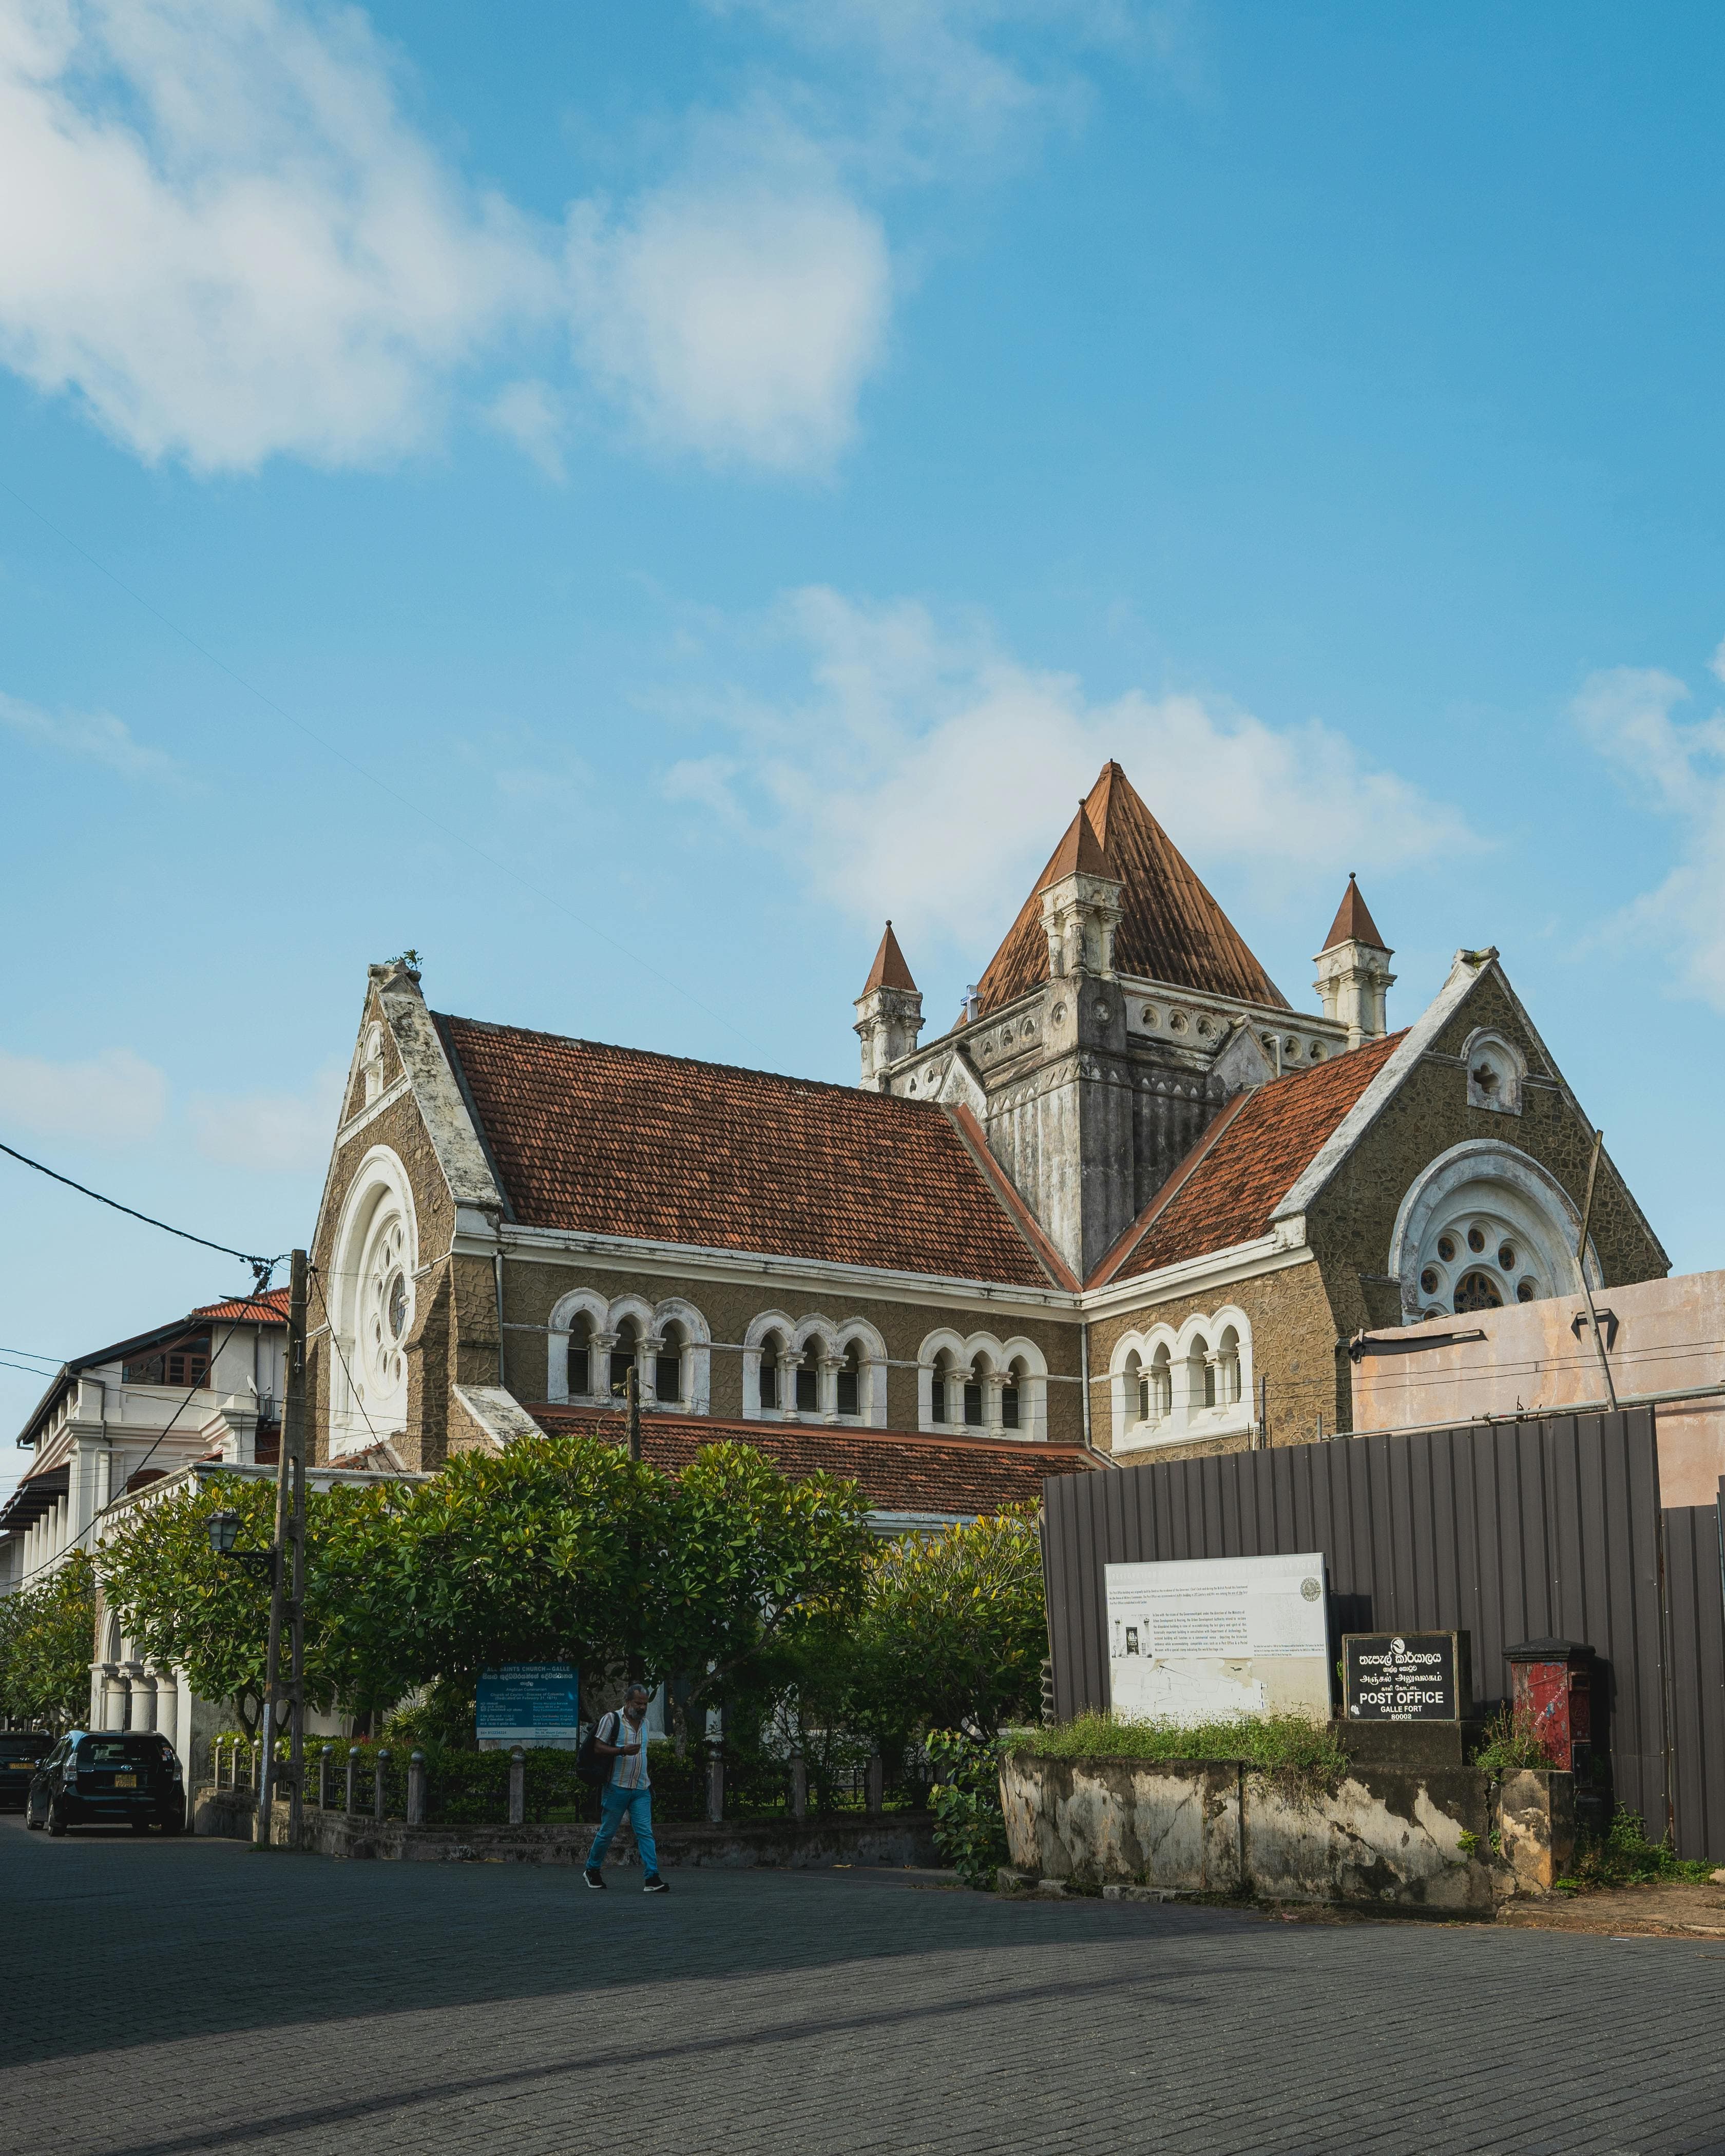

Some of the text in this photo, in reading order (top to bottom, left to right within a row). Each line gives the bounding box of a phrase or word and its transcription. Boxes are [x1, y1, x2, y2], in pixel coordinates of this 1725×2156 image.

[1359, 1652, 1392, 1666] තැපැල්
[1359, 1671, 1442, 1685] அஞ்சல் அலுவலகம்
[1360, 1692, 1444, 1704] POST OFFICE
